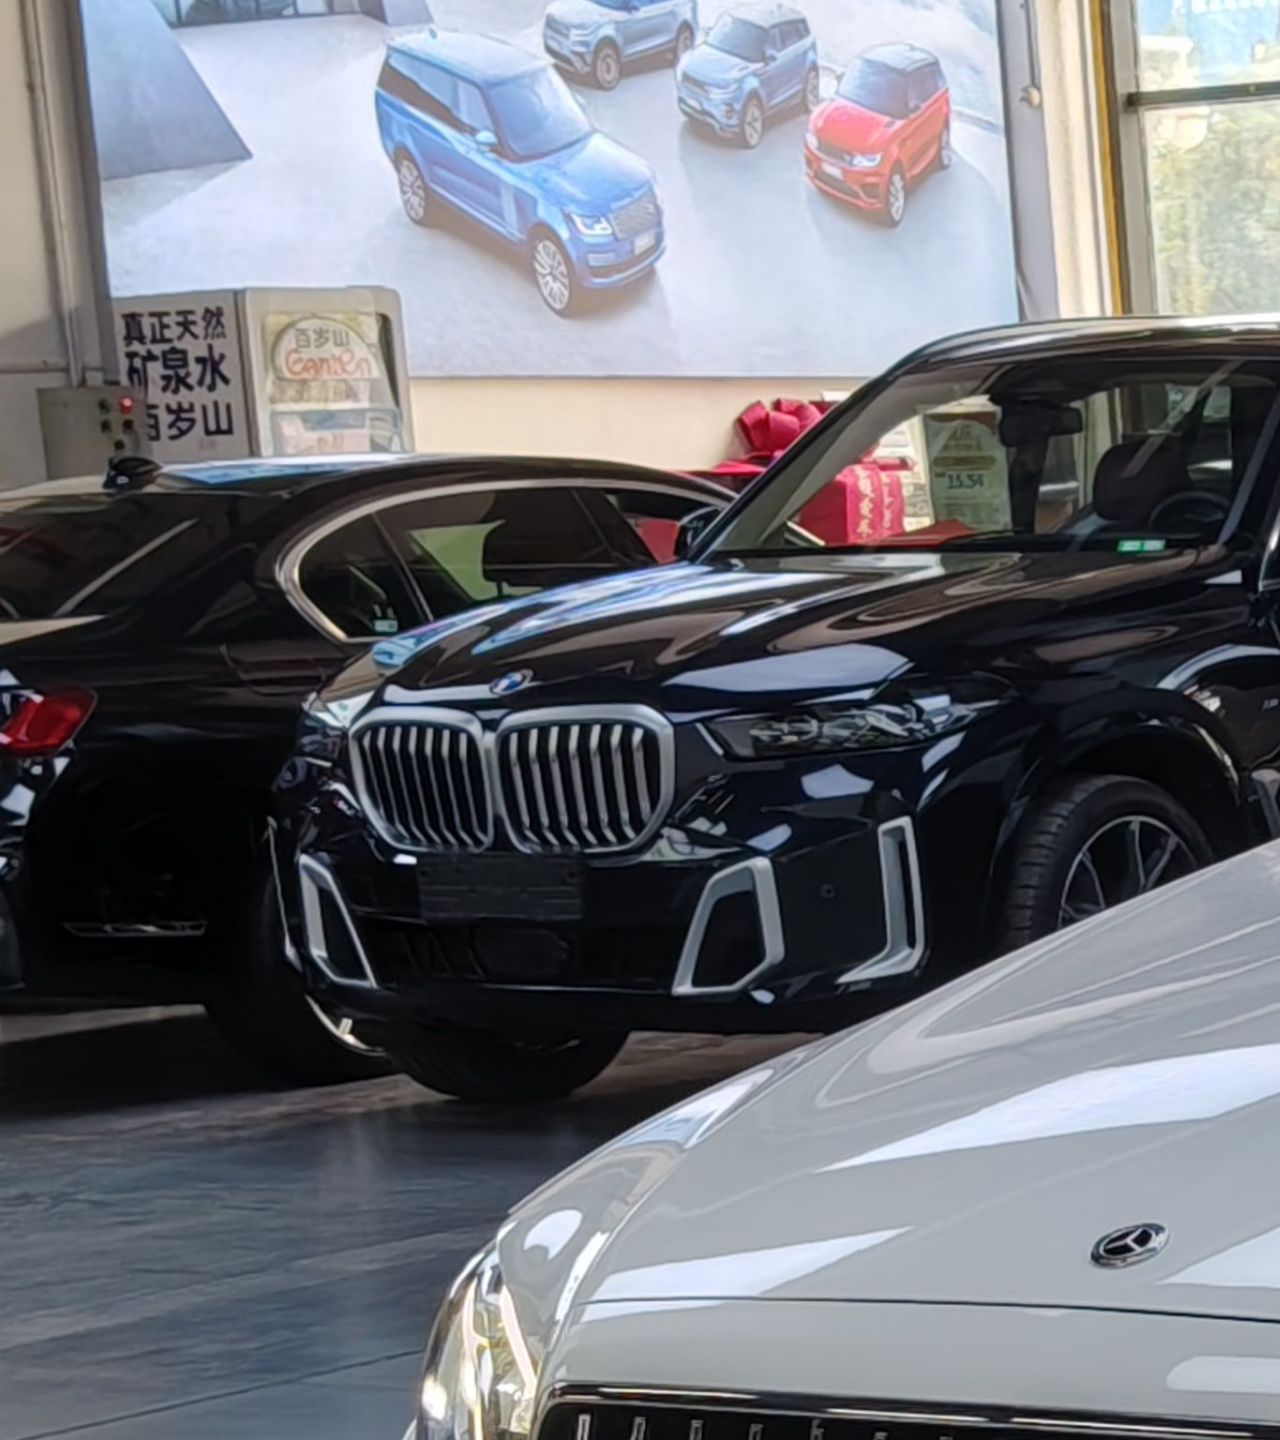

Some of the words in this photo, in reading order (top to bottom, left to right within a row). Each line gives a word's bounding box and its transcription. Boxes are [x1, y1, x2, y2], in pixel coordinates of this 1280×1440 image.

[121, 306, 226, 346] 真正天然
[125, 344, 230, 394] 矿泉水
